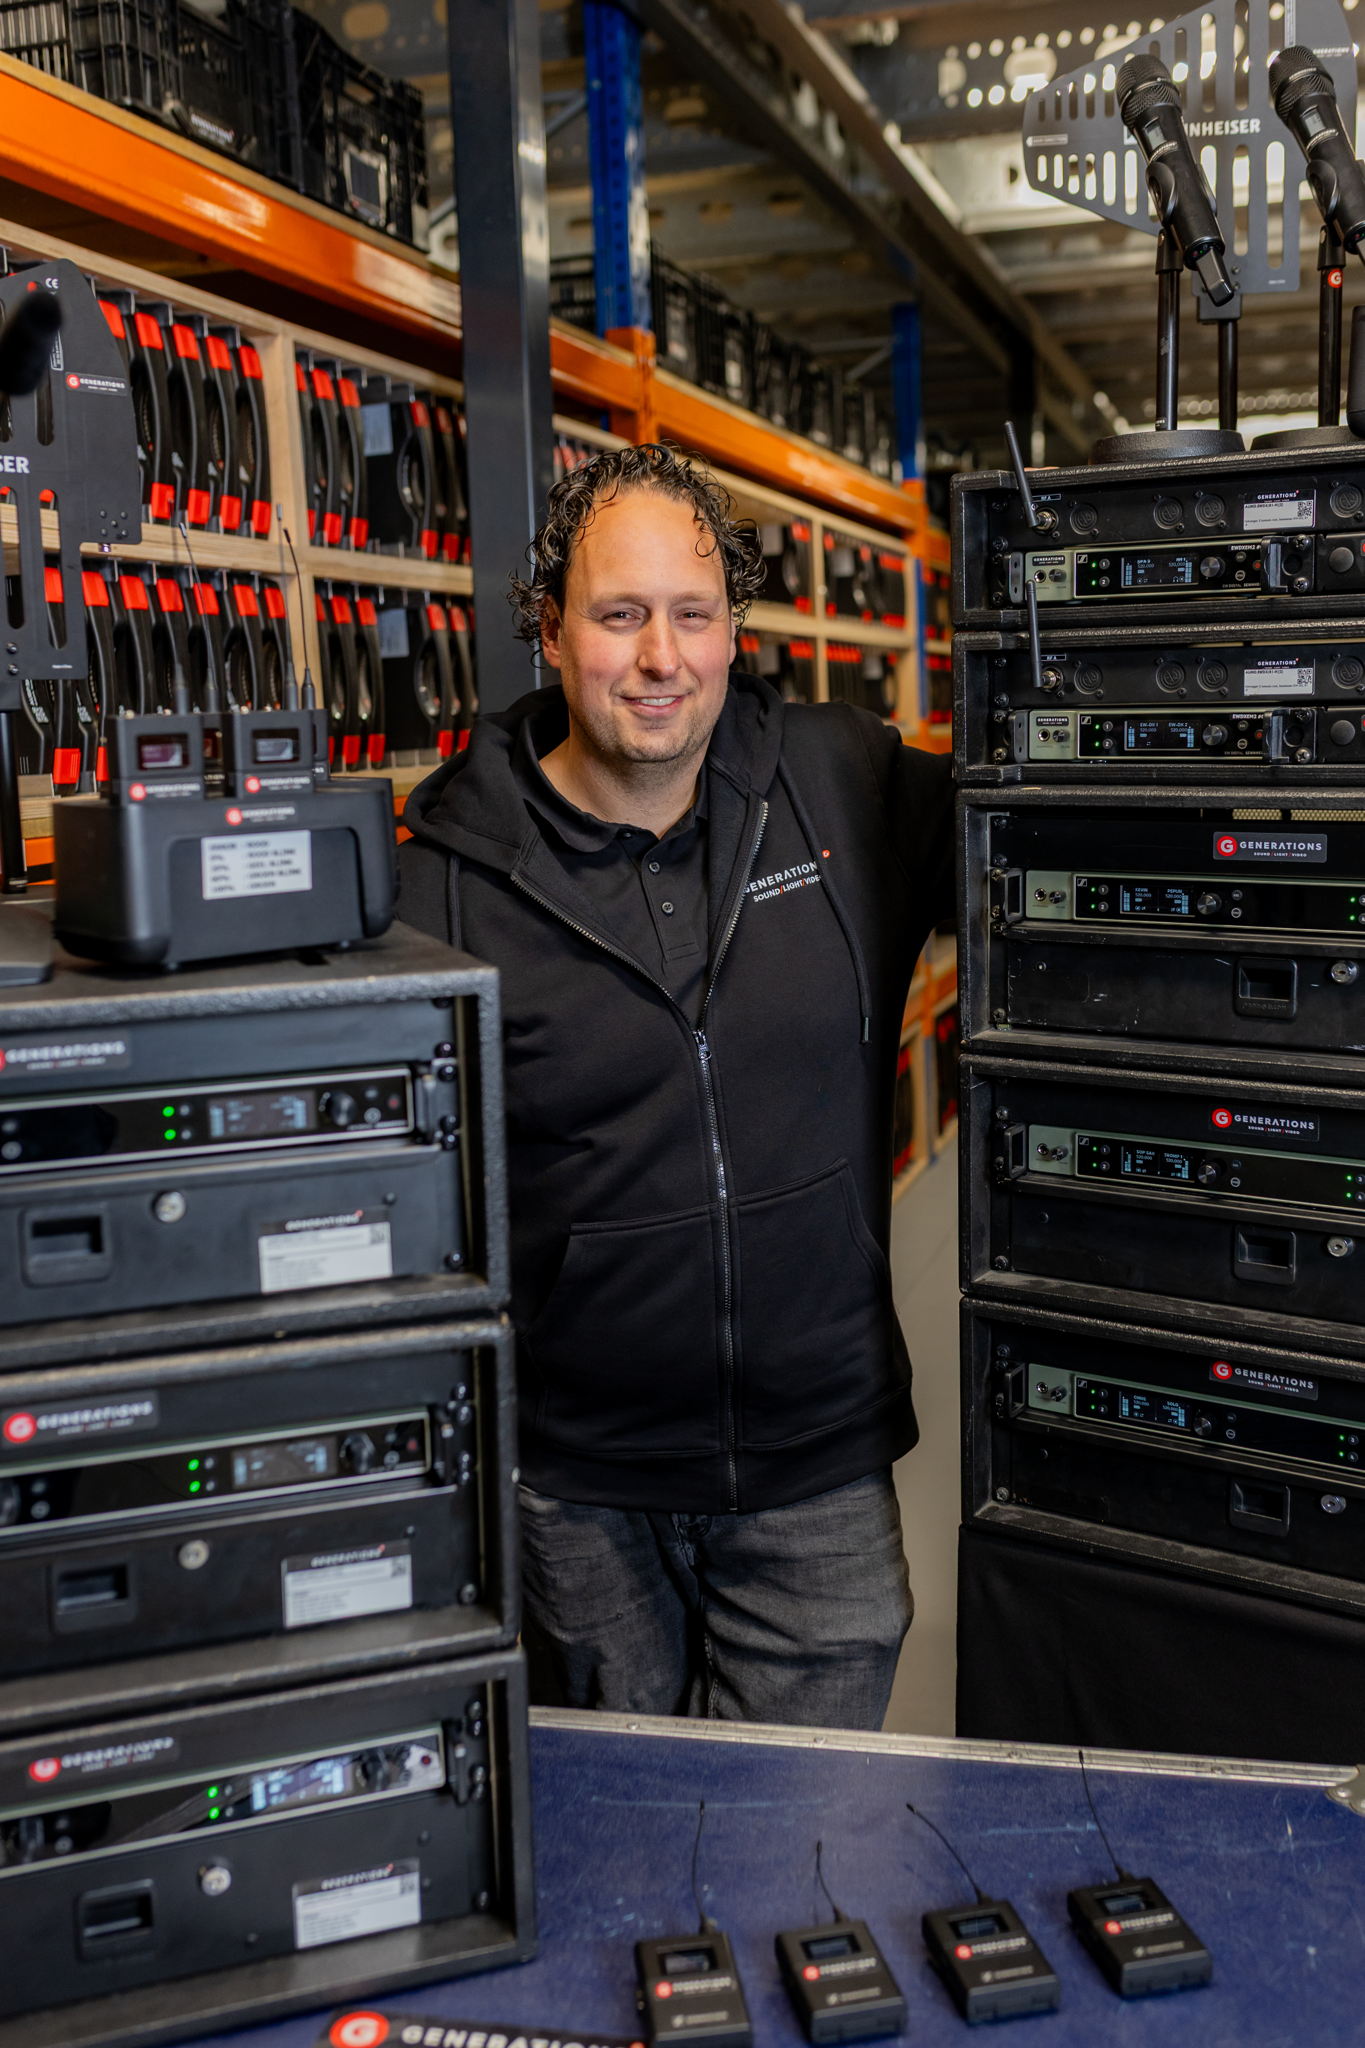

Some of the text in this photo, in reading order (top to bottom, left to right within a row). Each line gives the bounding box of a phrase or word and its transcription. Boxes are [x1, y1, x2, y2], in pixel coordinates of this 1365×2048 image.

[1257, 492, 1297, 500] GENERATIONS
[1240, 841, 1322, 851] GENERATIONS
[5, 1041, 126, 1063] GENERATIONS
[1234, 1114, 1315, 1130] GENERATIONS
[1234, 1368, 1314, 1389] GENERATIONS
[37, 1401, 153, 1430] GENERATIONS
